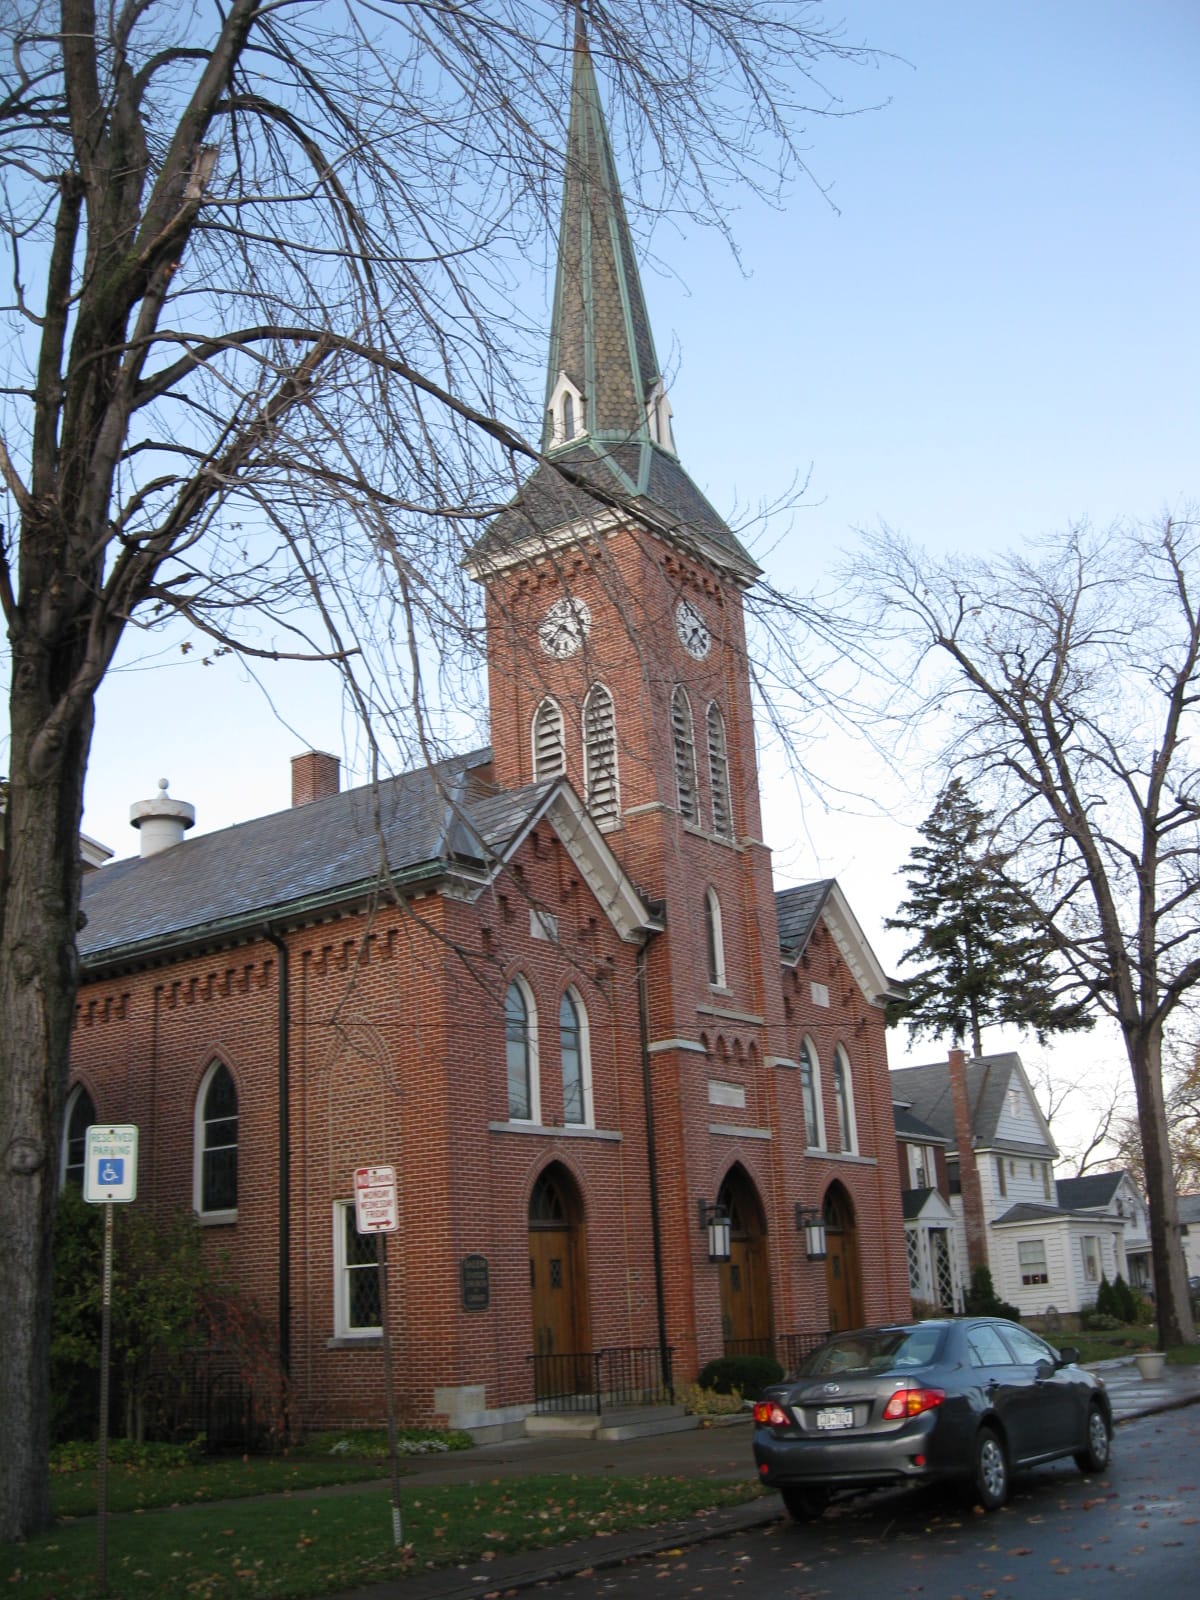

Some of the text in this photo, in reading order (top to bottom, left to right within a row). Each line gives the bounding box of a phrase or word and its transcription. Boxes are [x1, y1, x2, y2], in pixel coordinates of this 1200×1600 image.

[90, 1133, 134, 1143] RESERVED
[92, 1145, 131, 1155] PARKING
[363, 1190, 390, 1199] MONDAY
[365, 1210, 388, 1218] FRIDAY
